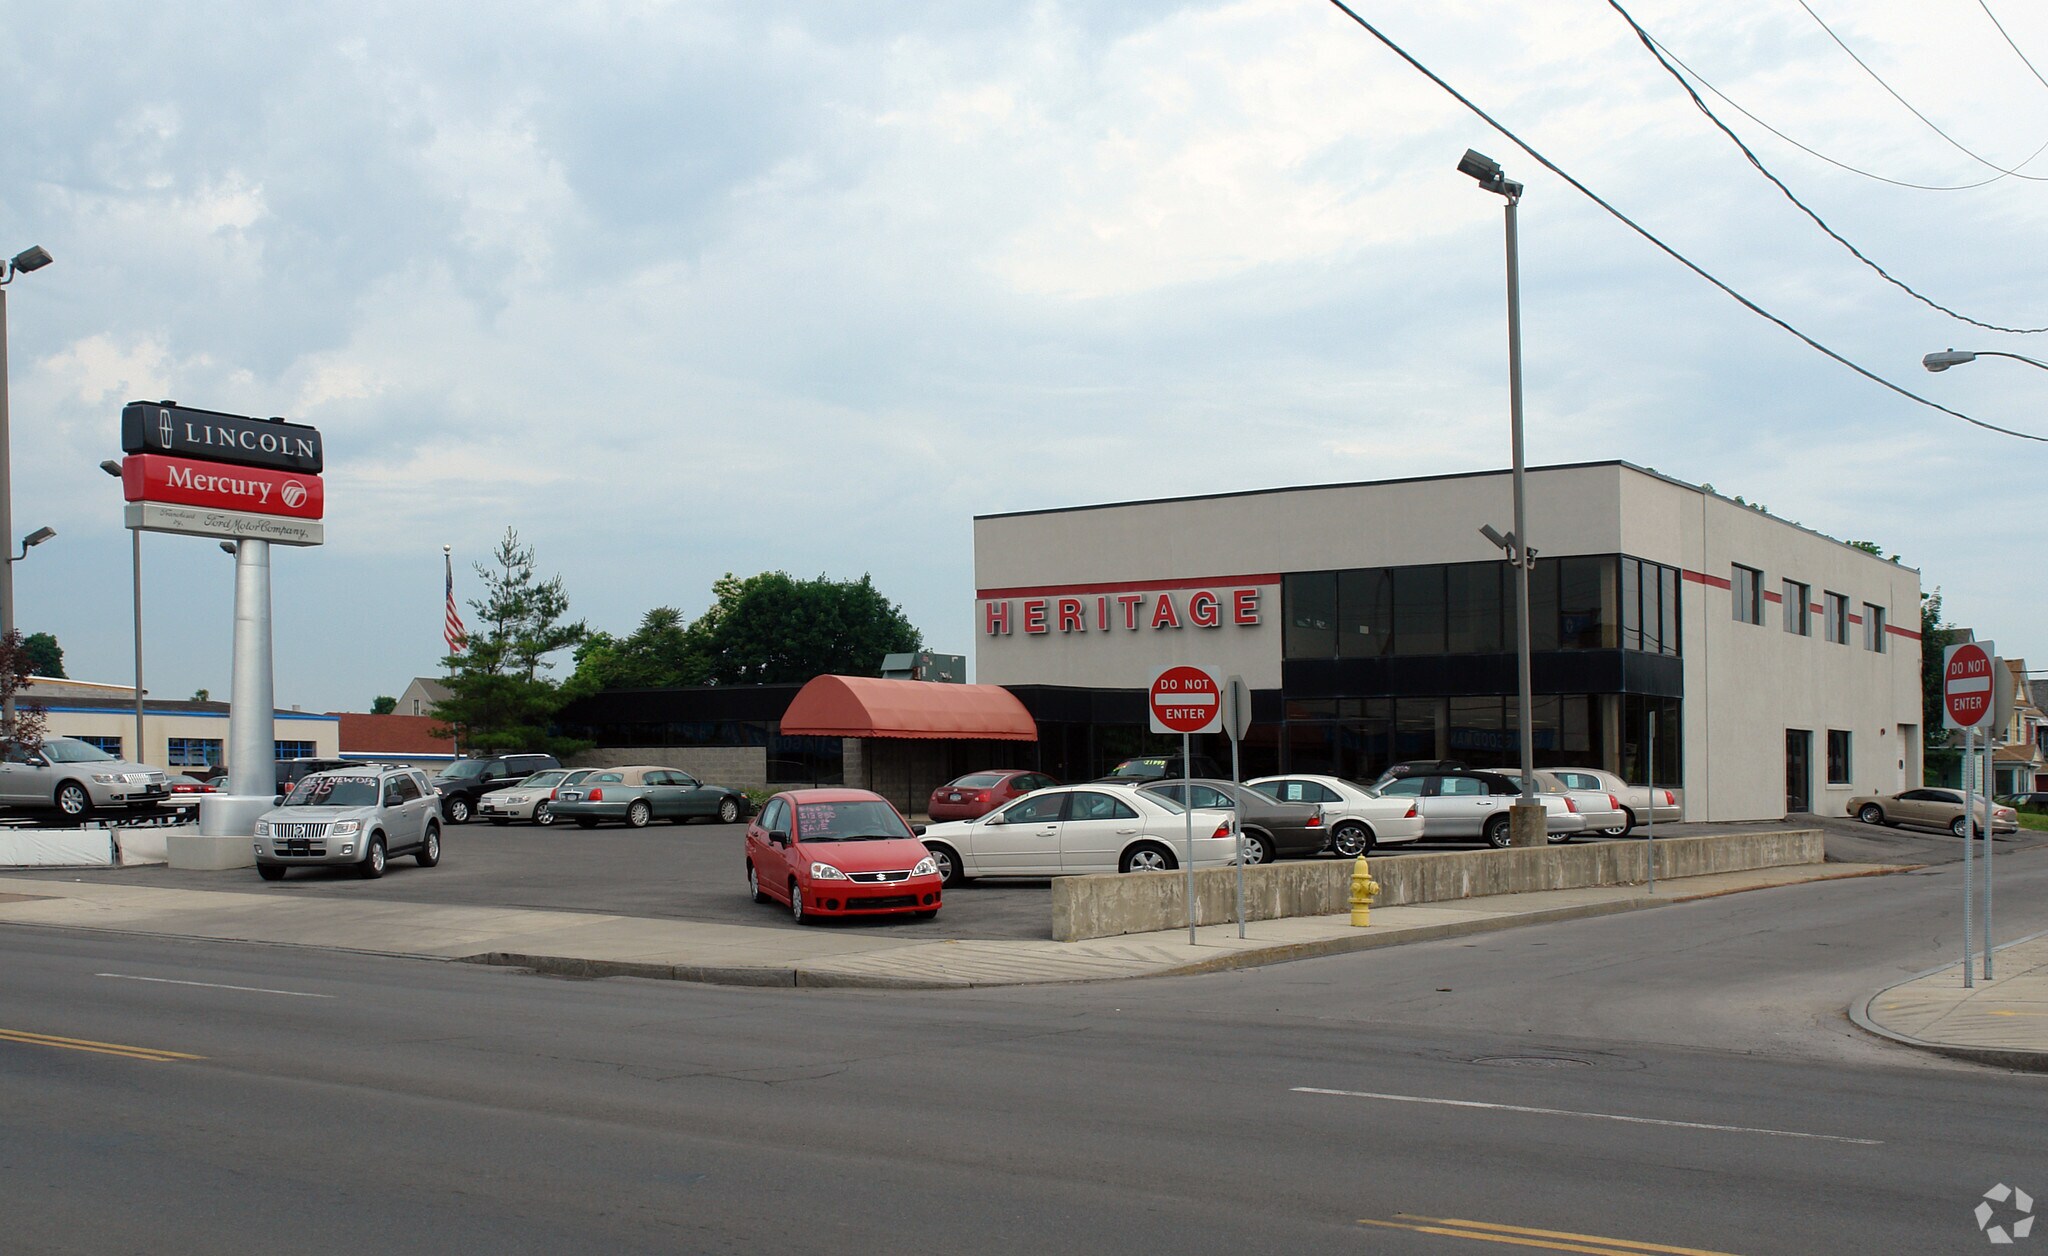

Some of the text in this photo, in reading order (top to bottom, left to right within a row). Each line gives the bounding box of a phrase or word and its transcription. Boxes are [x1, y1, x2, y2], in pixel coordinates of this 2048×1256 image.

[185, 422, 314, 458] LINCOLN
[165, 465, 272, 504] Mercury
[203, 514, 231, 531] Ford
[232, 518, 259, 534] Motor
[985, 588, 1262, 636] HERITAGE
[1951, 659, 1986, 675] DO NOT
[1160, 679, 1209, 690] DO NOT
[1954, 696, 1982, 711] ENTER
[1166, 708, 1205, 720] ENTER
[800, 823, 829, 833] SAVE
